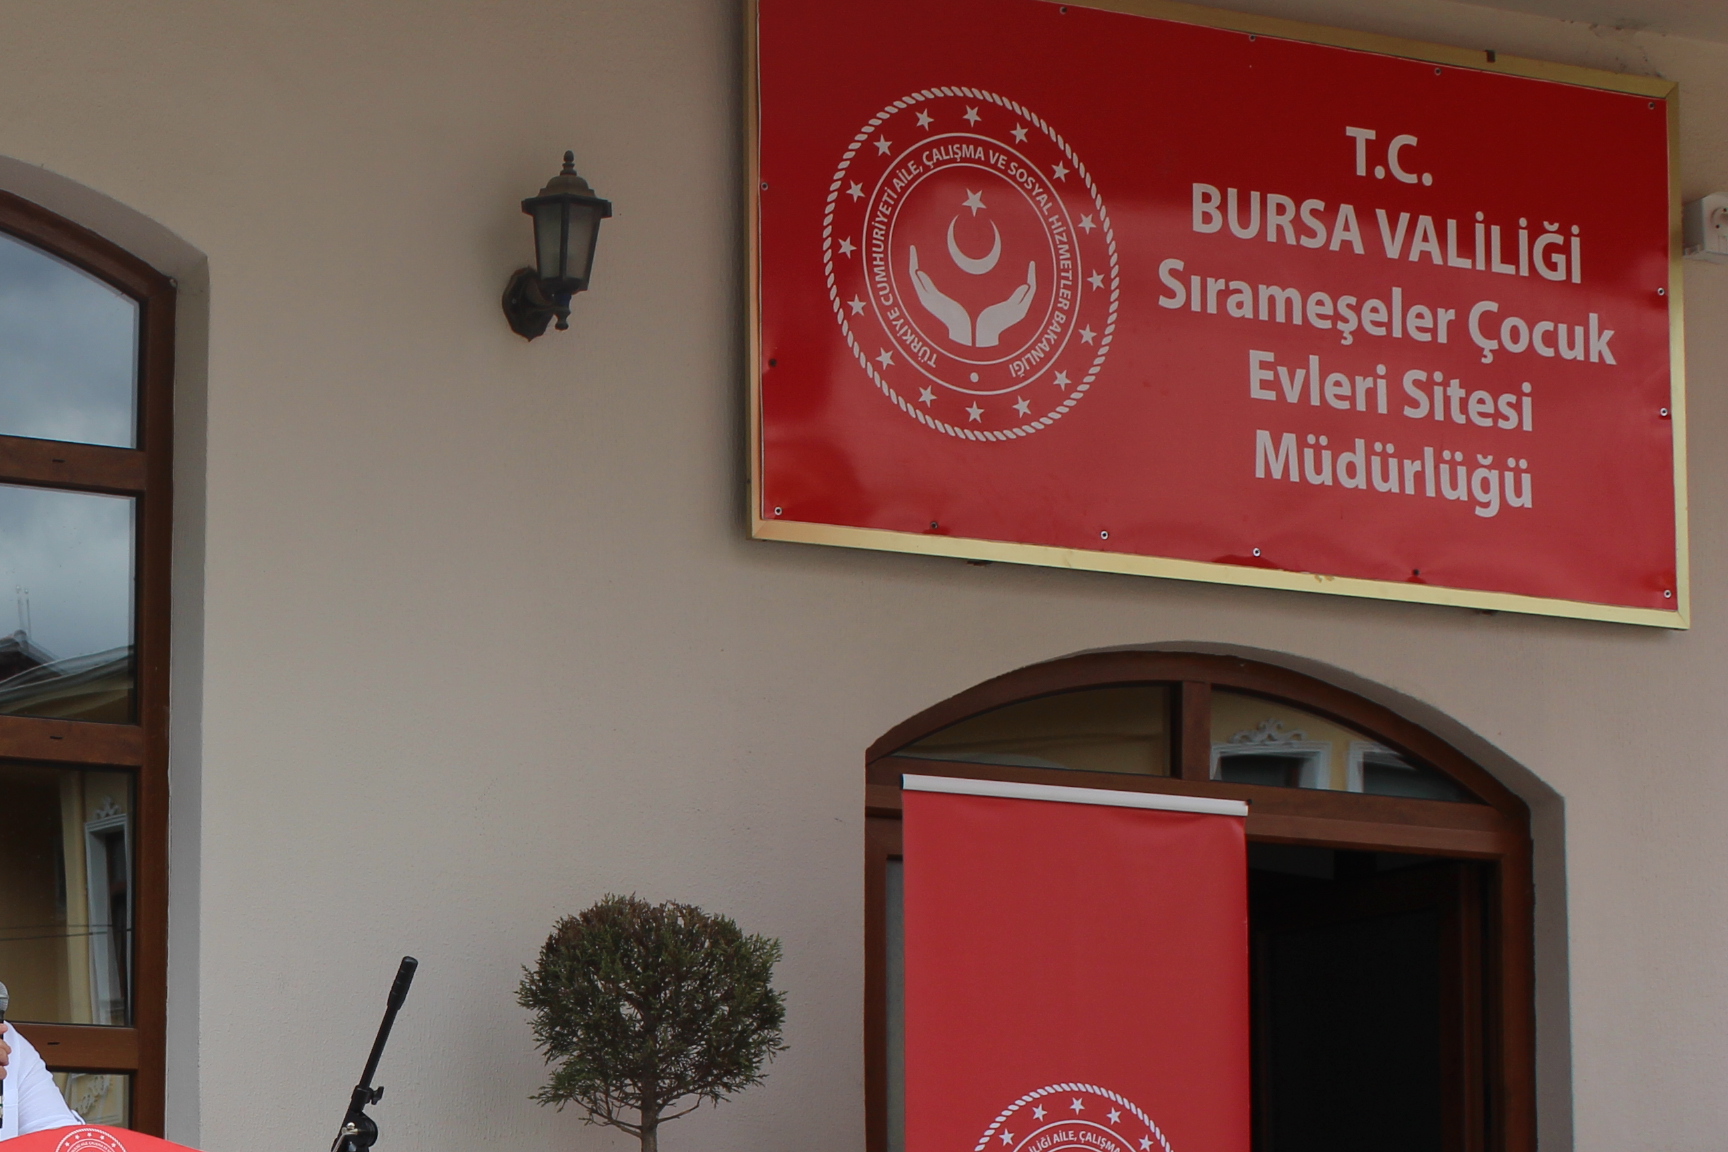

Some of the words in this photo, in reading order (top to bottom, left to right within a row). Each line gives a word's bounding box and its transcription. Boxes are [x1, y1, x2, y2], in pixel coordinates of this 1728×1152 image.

[893, 160, 923, 192] AİLE,
[923, 144, 984, 168] ÇALIŞMA
[990, 150, 1007, 169] VE
[1346, 126, 1432, 186] T.C.
[1008, 162, 1052, 215] SOSYAL
[872, 187, 897, 305] CUMHURİYETİ
[1049, 215, 1072, 310] HİZMETLER
[1193, 183, 1365, 254] BURSA
[1376, 209, 1581, 284] VALİLİĞİ
[887, 307, 936, 368] TÜRKİYE
[1159, 258, 1456, 345] Sırameşeler
[1469, 301, 1616, 365] Çocuk
[1009, 311, 1066, 377] BAKANLIĞI
[1250, 350, 1387, 414] Evleri
[1403, 370, 1532, 431] Sitesi
[1256, 430, 1532, 517] Müdürlüğü
[1054, 1130, 1077, 1143] AİLE,
